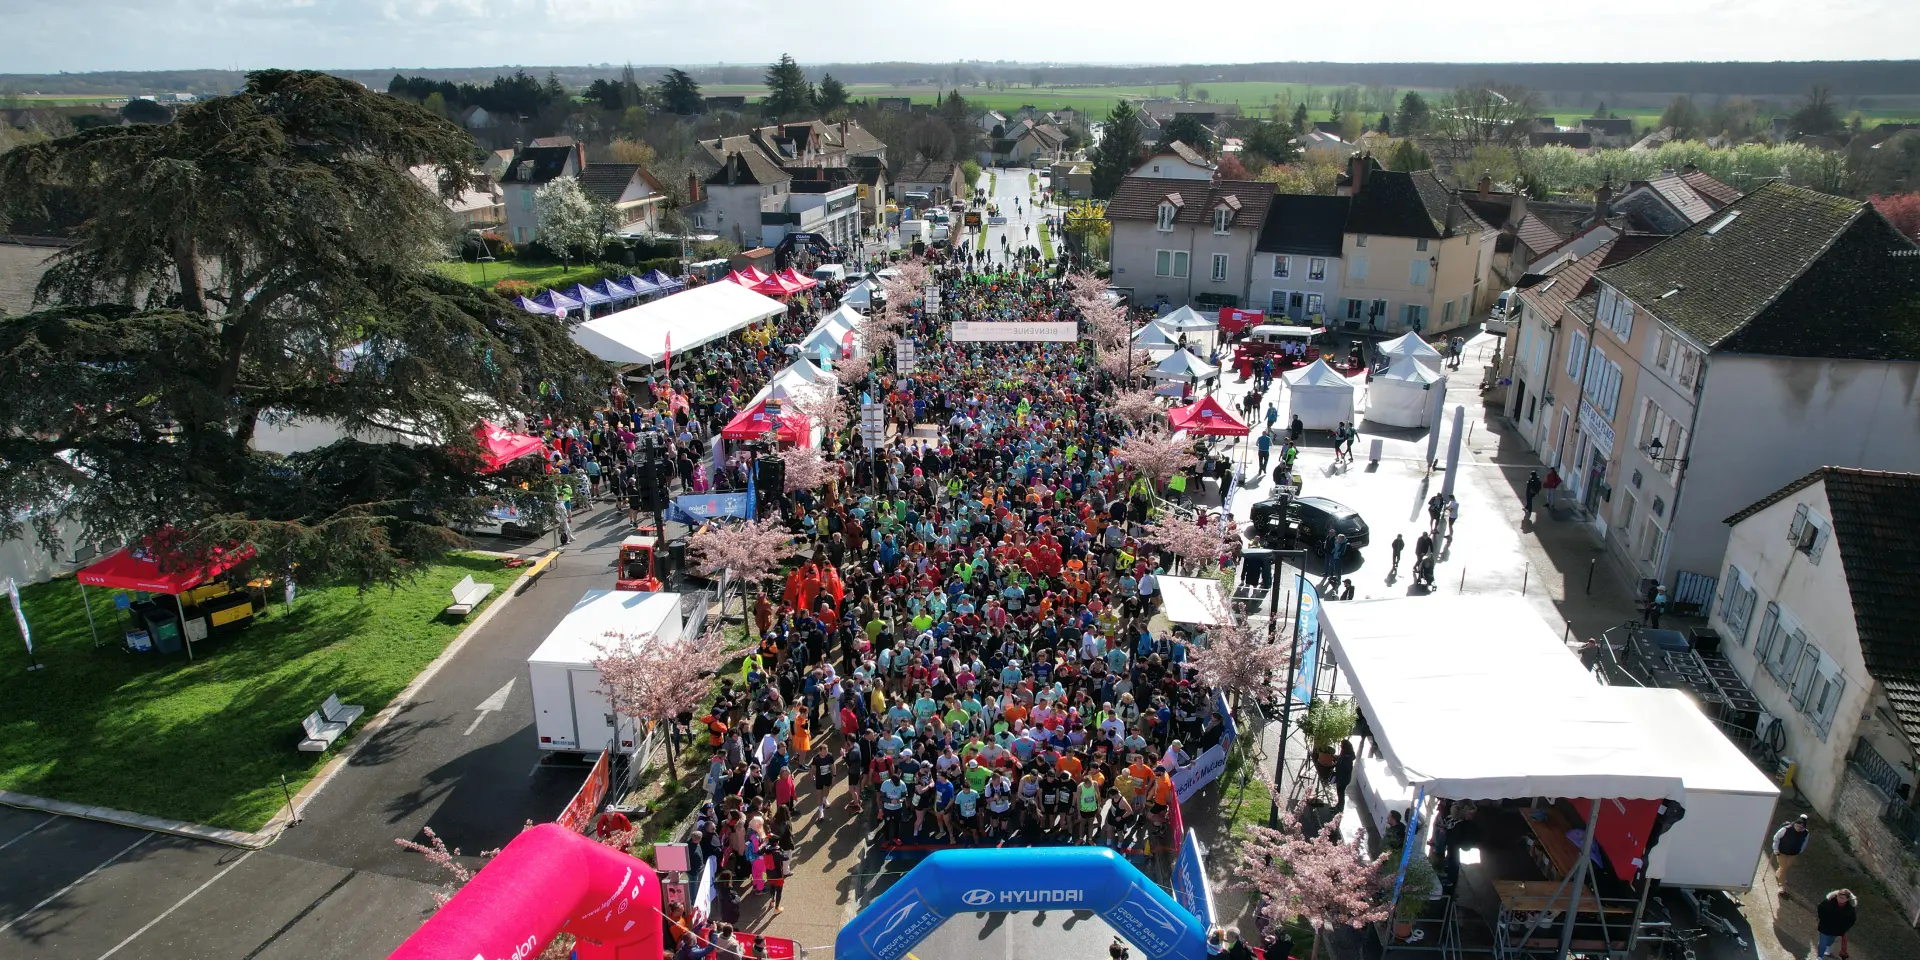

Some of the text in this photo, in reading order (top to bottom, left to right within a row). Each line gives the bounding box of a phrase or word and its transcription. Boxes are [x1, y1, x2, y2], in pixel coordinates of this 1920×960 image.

[1000, 889, 1083, 903] HYUNDAI
[878, 912, 931, 957] GROUPE GUILLET
[1112, 912, 1163, 953] AUTOMOBILES
[1117, 907, 1169, 949] GROUPE GUILLET
